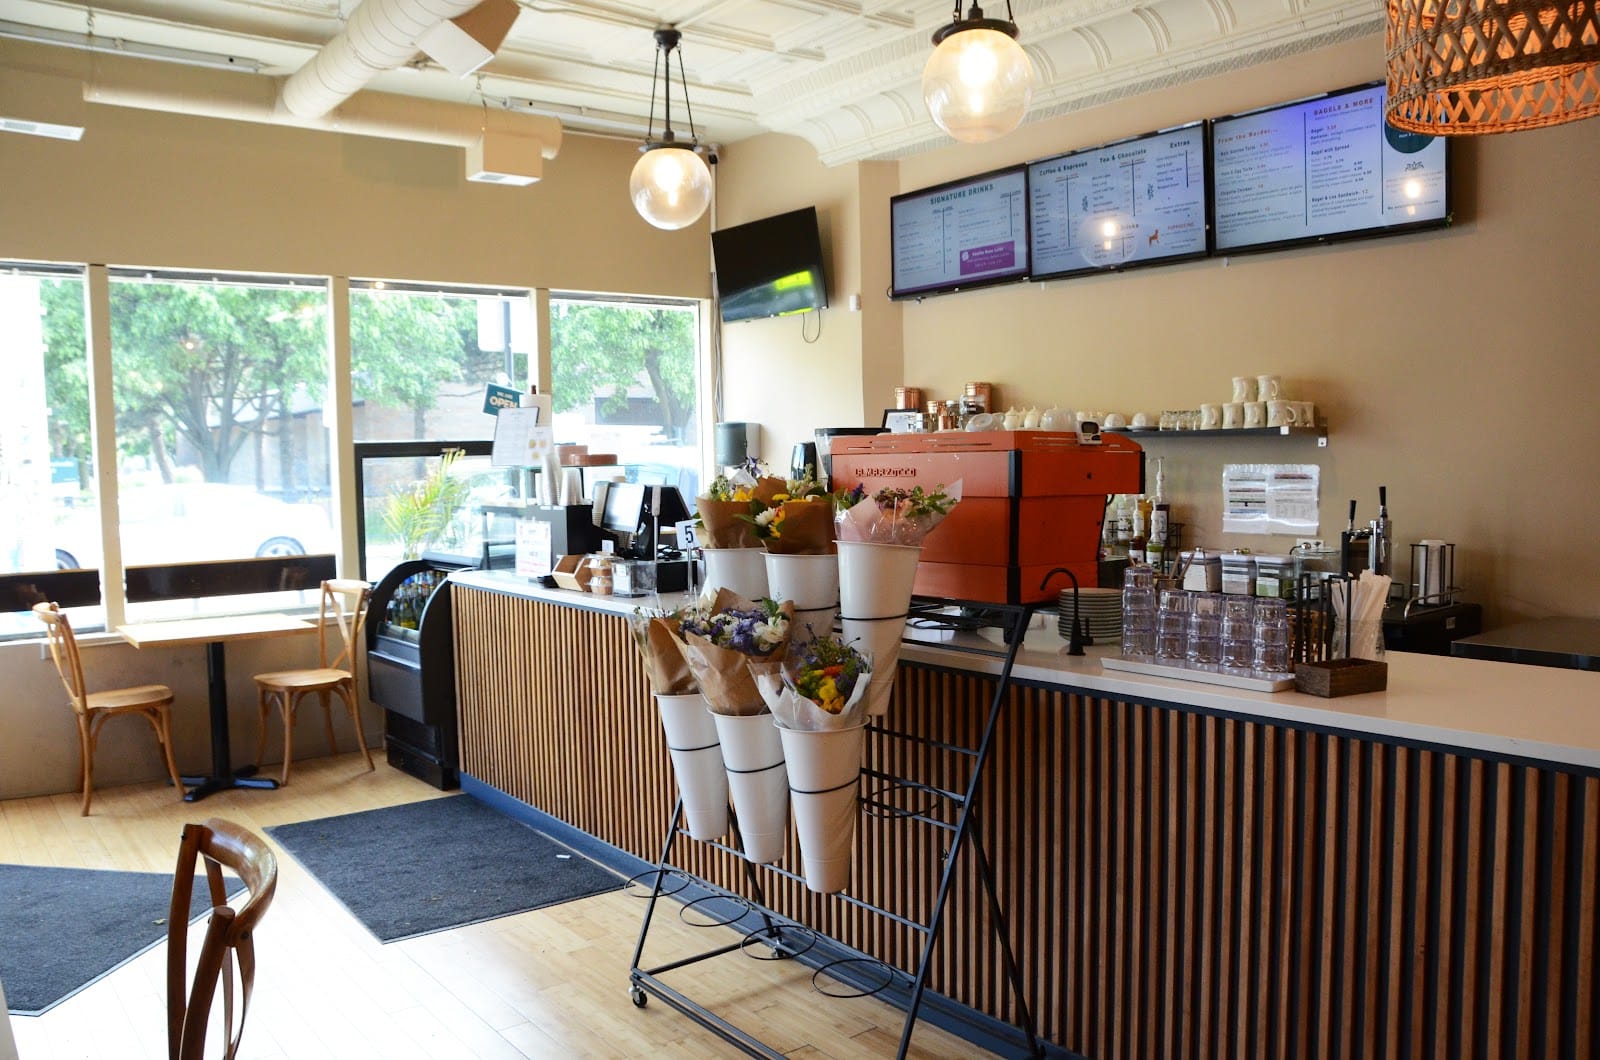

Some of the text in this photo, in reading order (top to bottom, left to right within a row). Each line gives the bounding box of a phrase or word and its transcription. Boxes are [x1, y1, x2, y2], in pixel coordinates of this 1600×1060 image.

[1313, 104, 1342, 116] BAGELS
[1353, 98, 1374, 107] MORE
[1169, 140, 1190, 149] Extras
[1100, 156, 1110, 164] Tea
[1117, 149, 1147, 159] Chocolate
[1039, 167, 1056, 176] Coffee
[1063, 162, 1088, 171] Espresso
[930, 190, 967, 205] SIGNATURE
[968, 183, 994, 196] DRINKS
[489, 395, 518, 408] OPEN
[684, 525, 694, 544] 5
